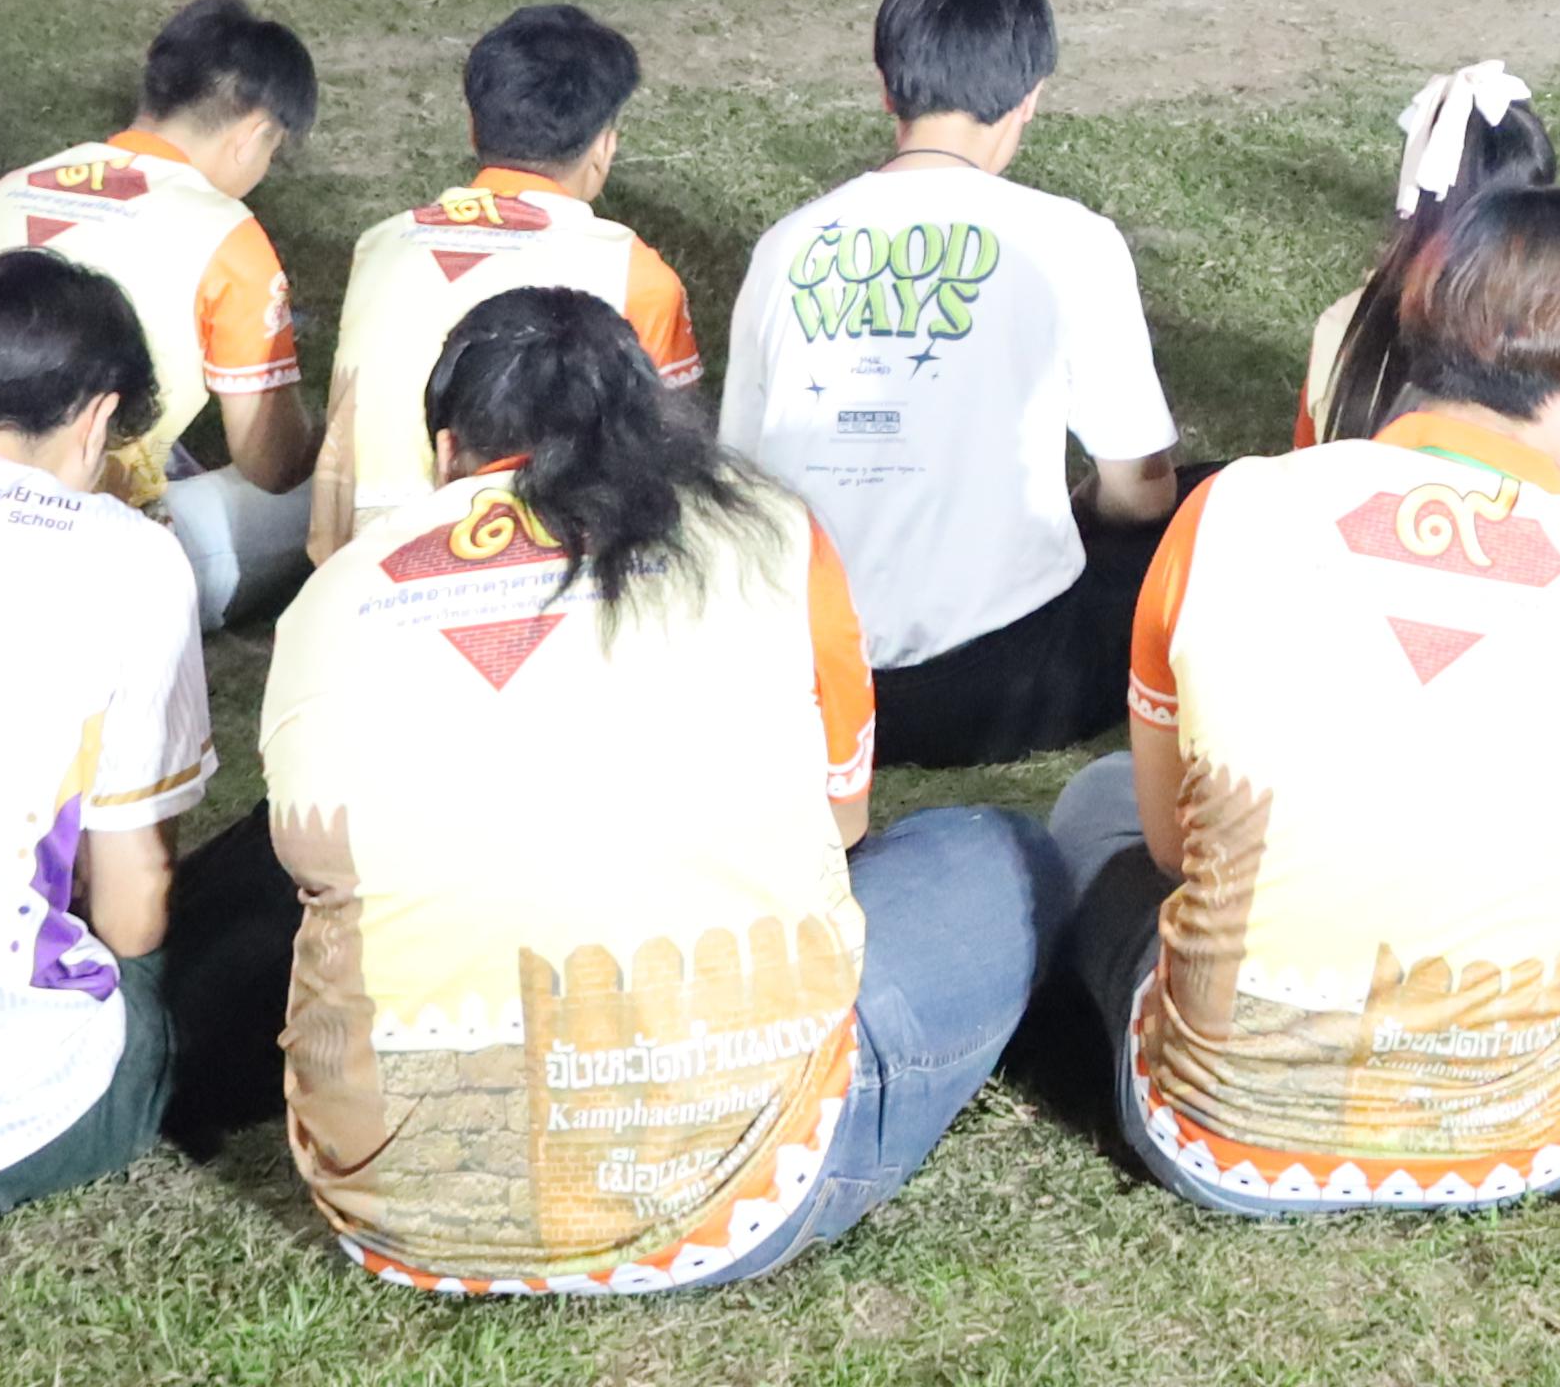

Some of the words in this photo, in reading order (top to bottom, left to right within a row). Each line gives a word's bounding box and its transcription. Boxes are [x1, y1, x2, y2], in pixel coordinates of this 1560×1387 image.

[788, 221, 1000, 290] GOOD
[791, 279, 980, 343] WAYS
[7, 510, 76, 532] School
